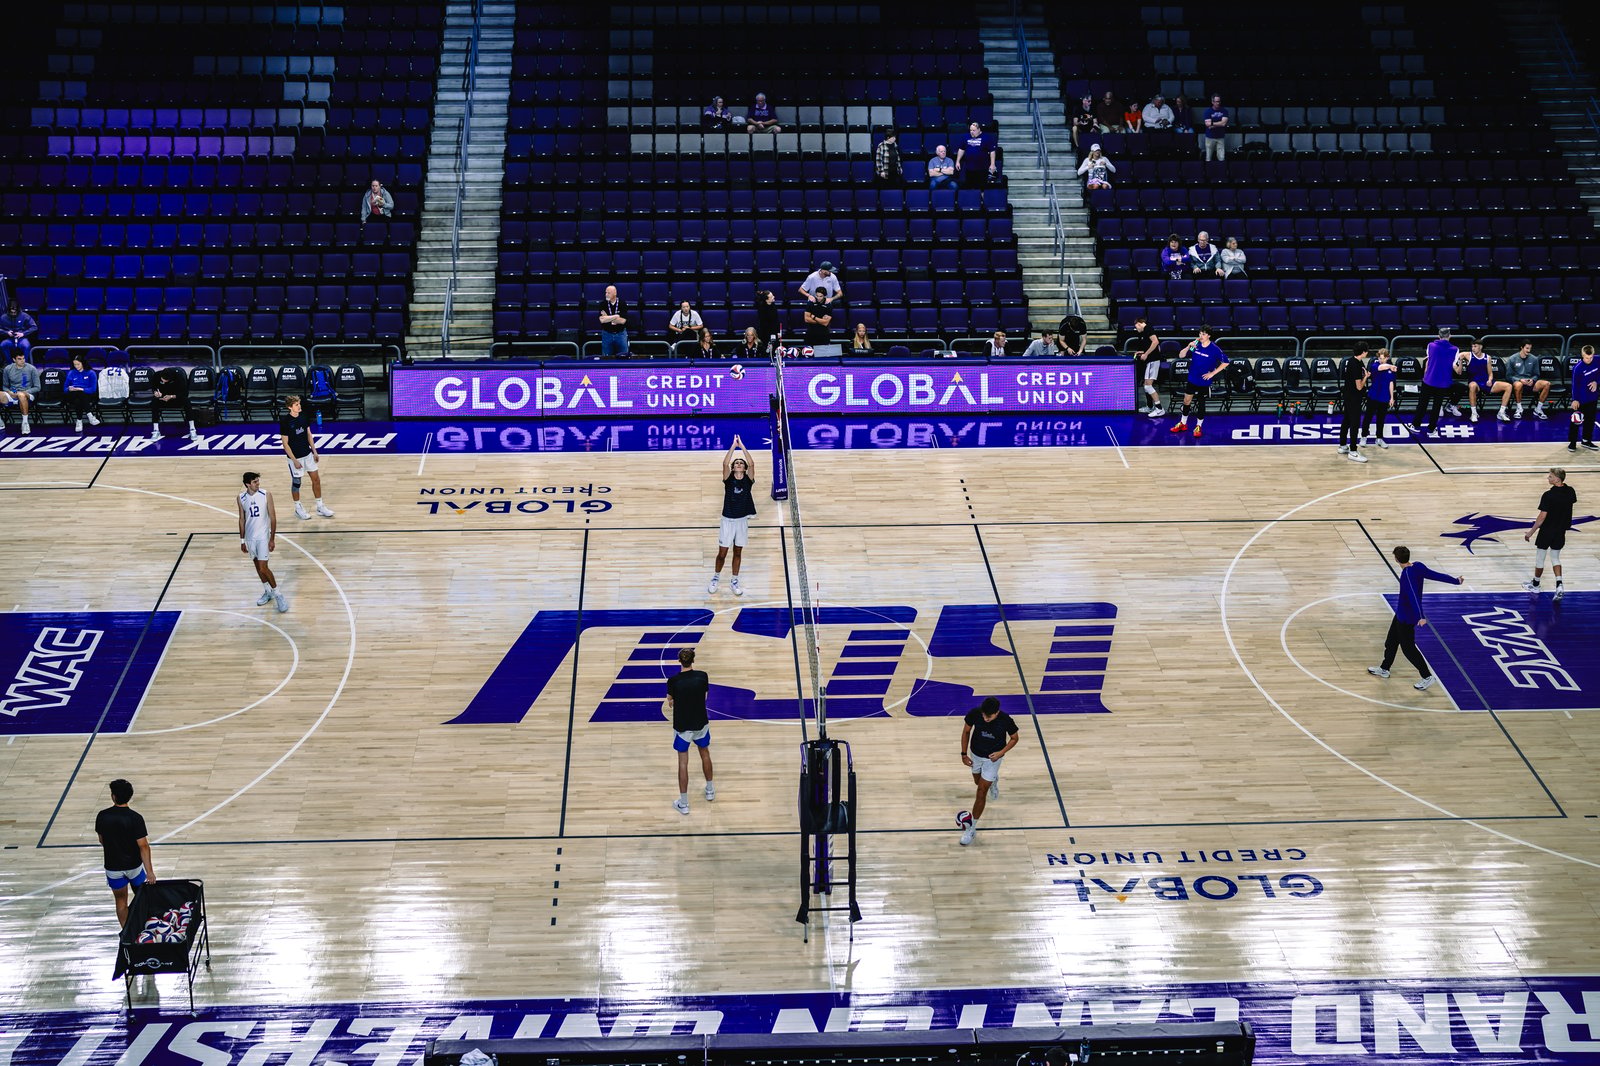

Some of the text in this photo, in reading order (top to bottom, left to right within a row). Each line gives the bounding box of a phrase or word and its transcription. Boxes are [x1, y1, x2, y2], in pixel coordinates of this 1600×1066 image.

[107, 366, 122, 377] 24
[1016, 372, 1093, 386] CREDIT
[646, 374, 724, 389] CREDIT
[807, 371, 1004, 406] GLOBAL
[433, 374, 634, 410] GLOBAL
[646, 393, 716, 407] UNION
[1016, 390, 1084, 404] UNION
[0, 435, 165, 452] ARIZO
[420, 485, 612, 497] CREDIT UNION
[249, 505, 260, 518] 12
[417, 499, 613, 515] GLOBAL
[1461, 606, 1582, 692] WAC
[0, 627, 105, 717] WAC
[1046, 848, 1307, 866] CREDIT UNION
[1053, 873, 1324, 904] GLOBAL
